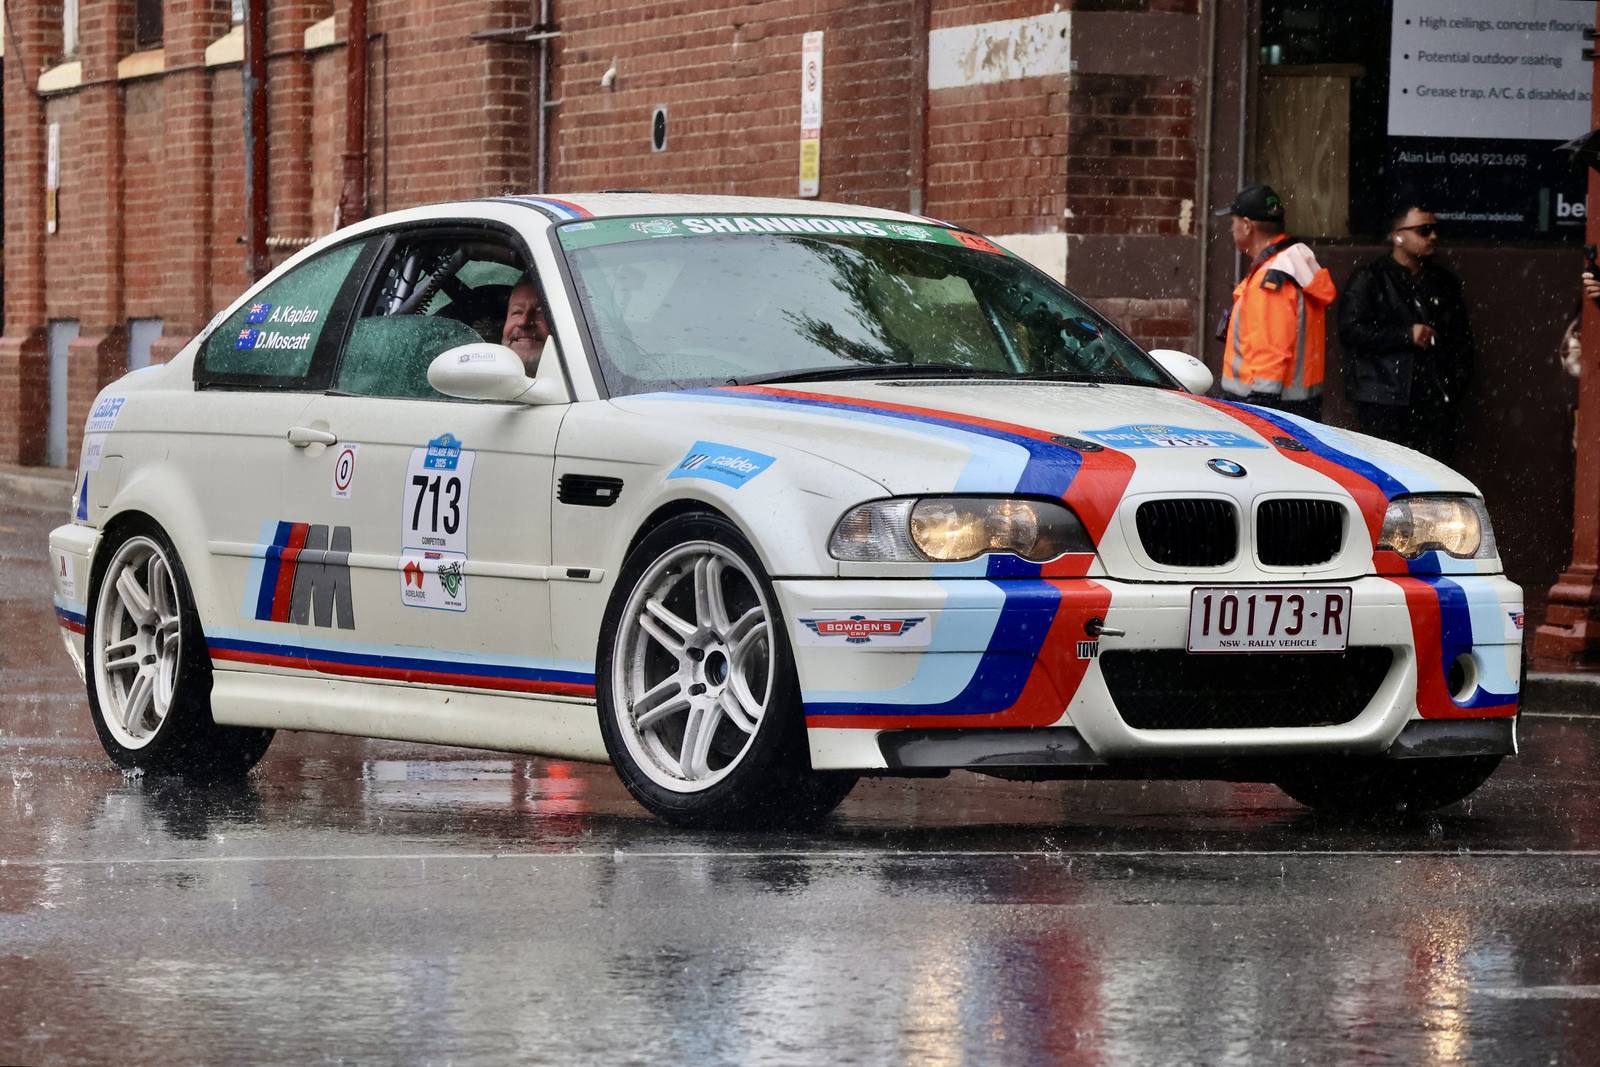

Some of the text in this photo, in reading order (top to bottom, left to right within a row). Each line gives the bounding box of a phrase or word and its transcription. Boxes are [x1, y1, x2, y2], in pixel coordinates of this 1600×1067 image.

[1419, 16, 1447, 30] High
[1496, 20, 1547, 31] concrete
[1418, 51, 1563, 68] Potential outdoor seating
[1416, 85, 1457, 97] Grease
[1515, 88, 1526, 100] &
[1527, 88, 1576, 101] disabled
[1399, 151, 1424, 163] Alan
[1450, 153, 1480, 165] 0404
[682, 217, 888, 236] SHANNONS
[269, 305, 319, 327] A.Kaplan
[255, 332, 311, 350] D.Moscatt
[1158, 438, 1210, 446] 713
[712, 456, 760, 473] calder
[412, 475, 462, 535] 713
[422, 537, 446, 546] COMPETITION
[405, 589, 426, 599] ADELAIDE
[827, 623, 892, 631] BOWDEN'S
[1077, 642, 1099, 658] TOW
[1279, 639, 1318, 647] VEHICLE
